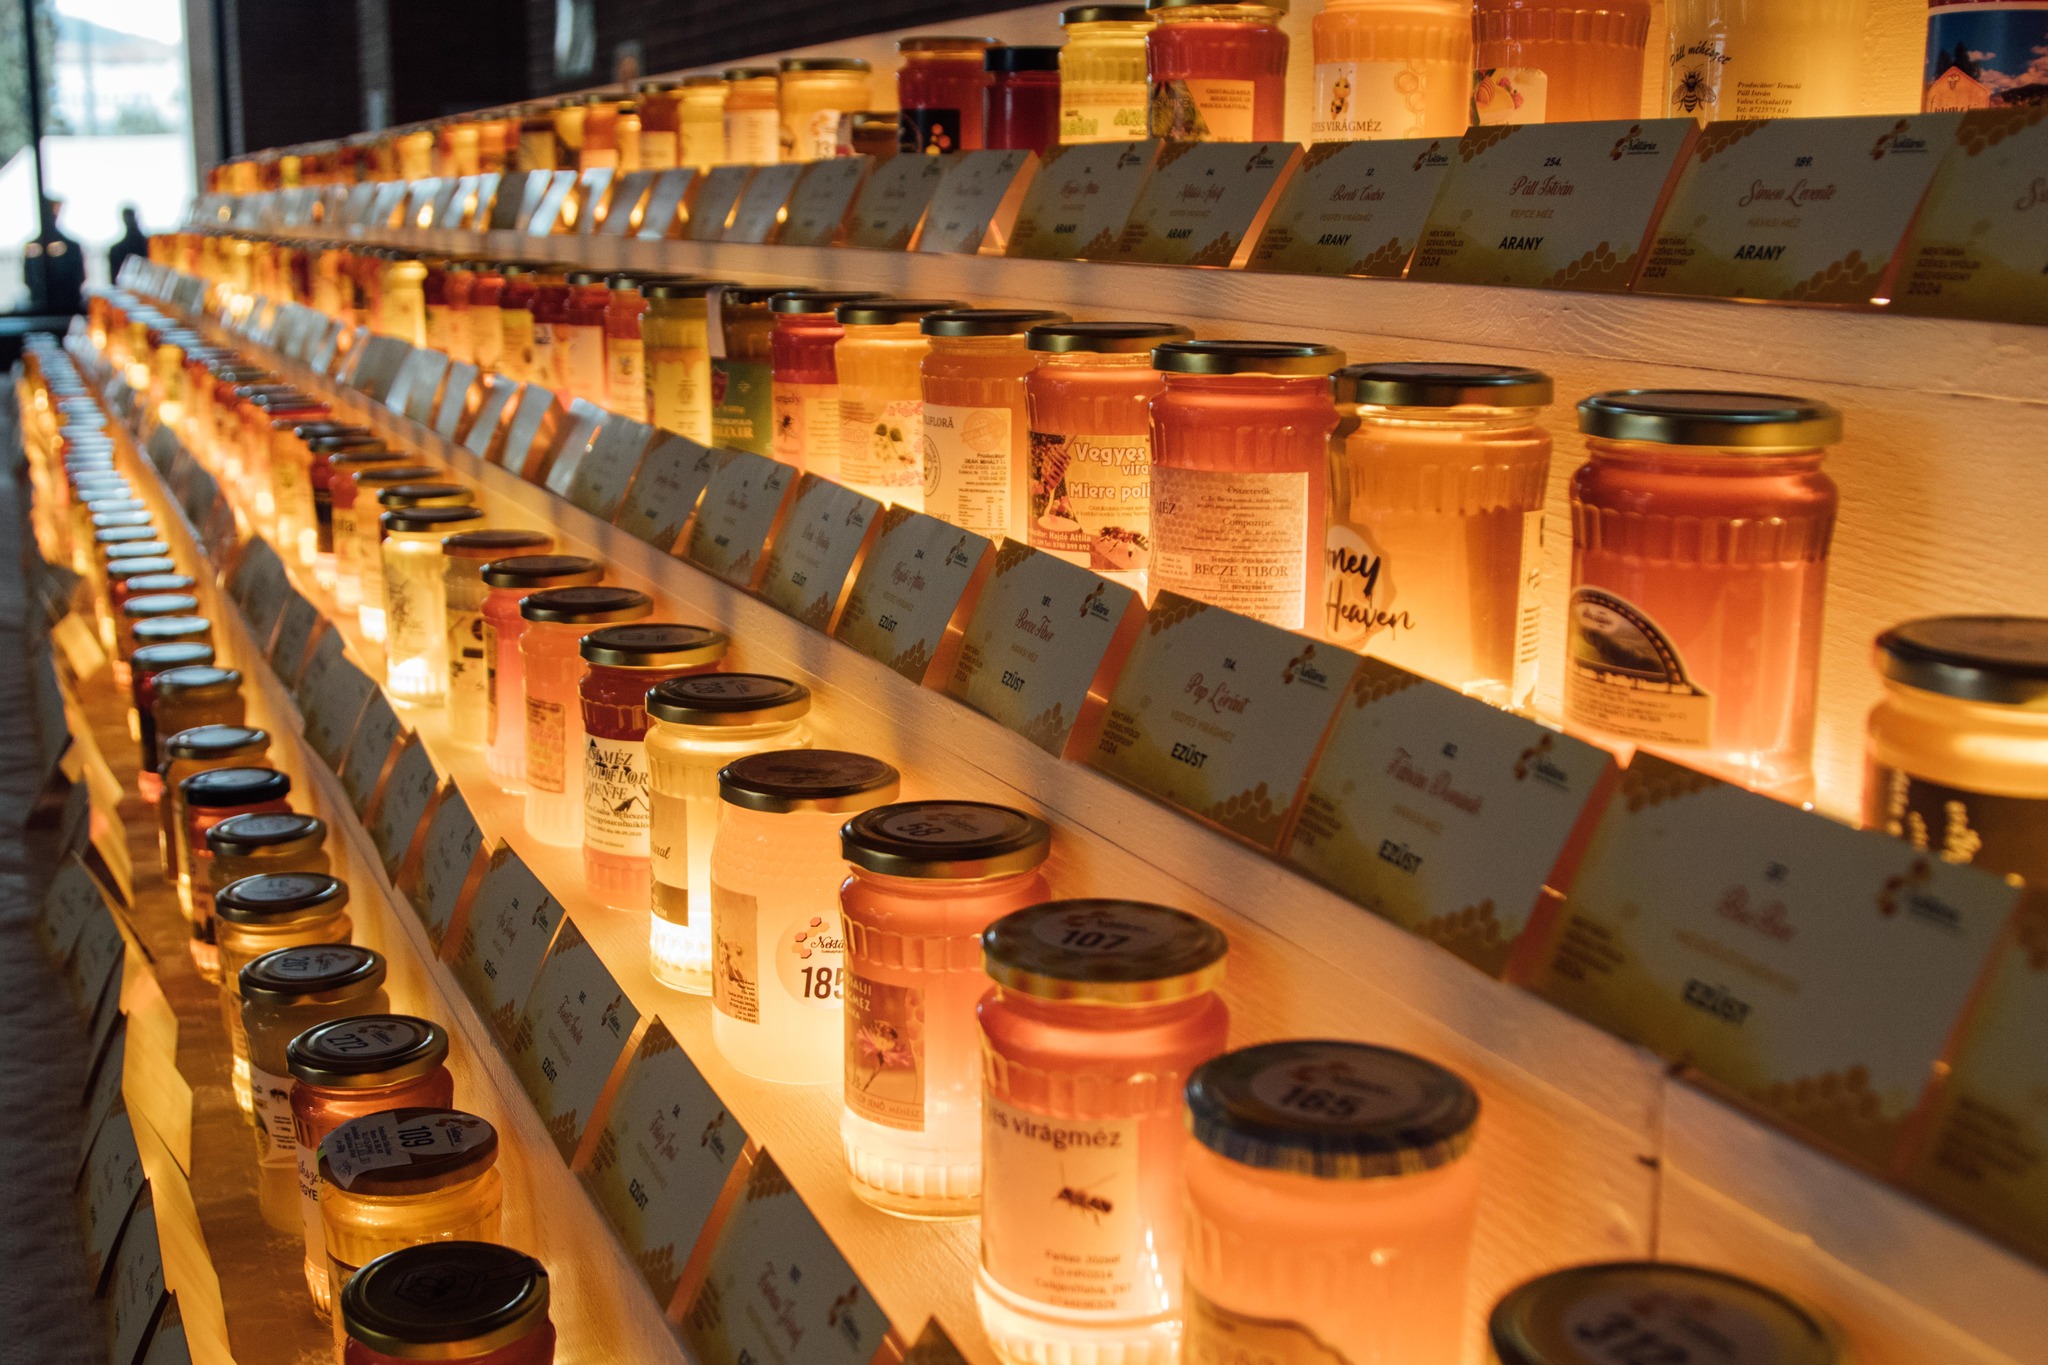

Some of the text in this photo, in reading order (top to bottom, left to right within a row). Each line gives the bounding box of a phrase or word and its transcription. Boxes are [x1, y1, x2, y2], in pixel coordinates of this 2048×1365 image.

[1325, 118, 1382, 133] VIRÁGMÉZ
[1166, 228, 1194, 239] ARANY
[1316, 234, 1352, 246] ARANY
[1498, 235, 1544, 251] ARANY
[1419, 256, 1440, 267] 2024
[1734, 244, 1787, 261] ARANY
[1075, 442, 1147, 467] Vegyes
[1069, 480, 1117, 500] Miere
[1193, 563, 1289, 578] BECZE TIBOR
[1326, 547, 1381, 600] ney
[1326, 579, 1414, 641] Heaven
[877, 614, 899, 633] EZÜST
[1001, 669, 1027, 693] EZÜST
[1170, 741, 1209, 770] EZÜST
[652, 845, 671, 860] nal
[1377, 838, 1423, 876] EZÜST
[1060, 929, 1131, 951] 107
[801, 966, 844, 1000] 185
[326, 1032, 369, 1054] 272
[542, 1056, 558, 1084] EZÜST
[397, 1125, 436, 1149] 109
[1013, 1117, 1123, 1151] virágméz
[629, 1178, 649, 1212] EZÜST
